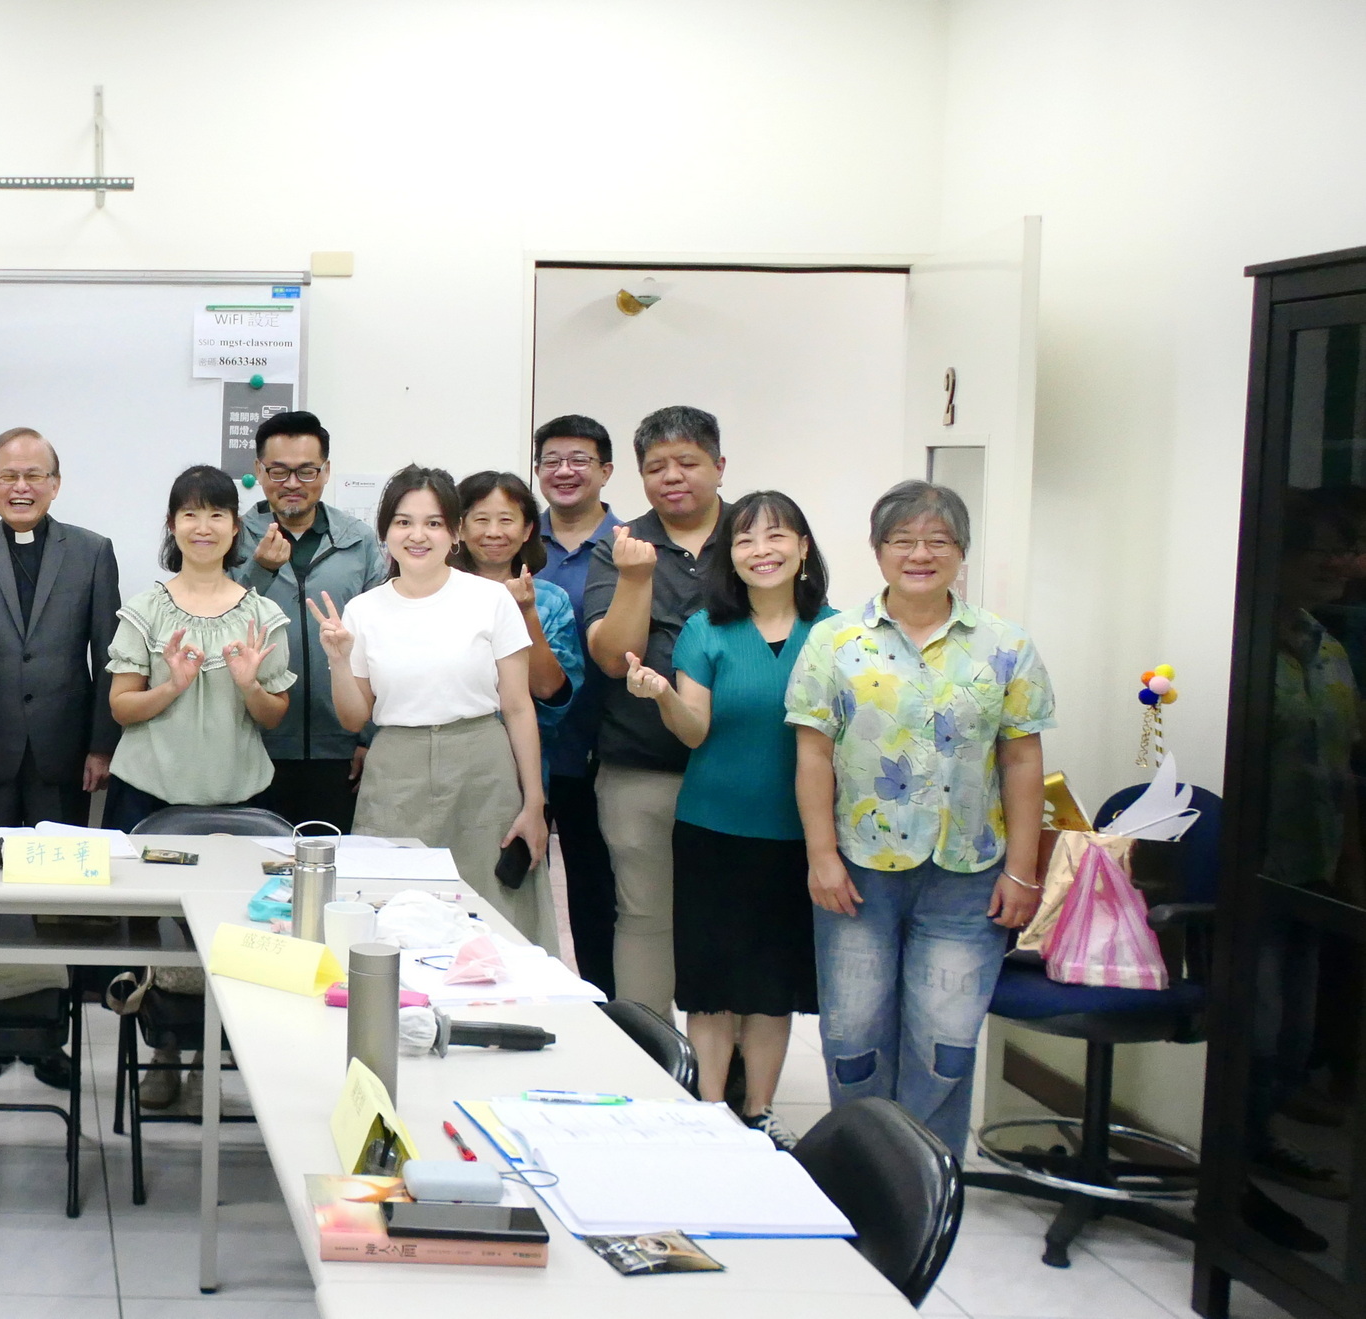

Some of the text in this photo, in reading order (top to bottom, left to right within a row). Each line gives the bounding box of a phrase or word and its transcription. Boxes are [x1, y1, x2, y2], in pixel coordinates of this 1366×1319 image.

[214, 312, 280, 328] WiFI 設定
[219, 338, 293, 348] mgst-classroom
[219, 356, 268, 366] 86633488
[943, 367, 955, 425] 2
[229, 411, 260, 423] 離開時
[365, 1243, 418, 1258] 神人之間
